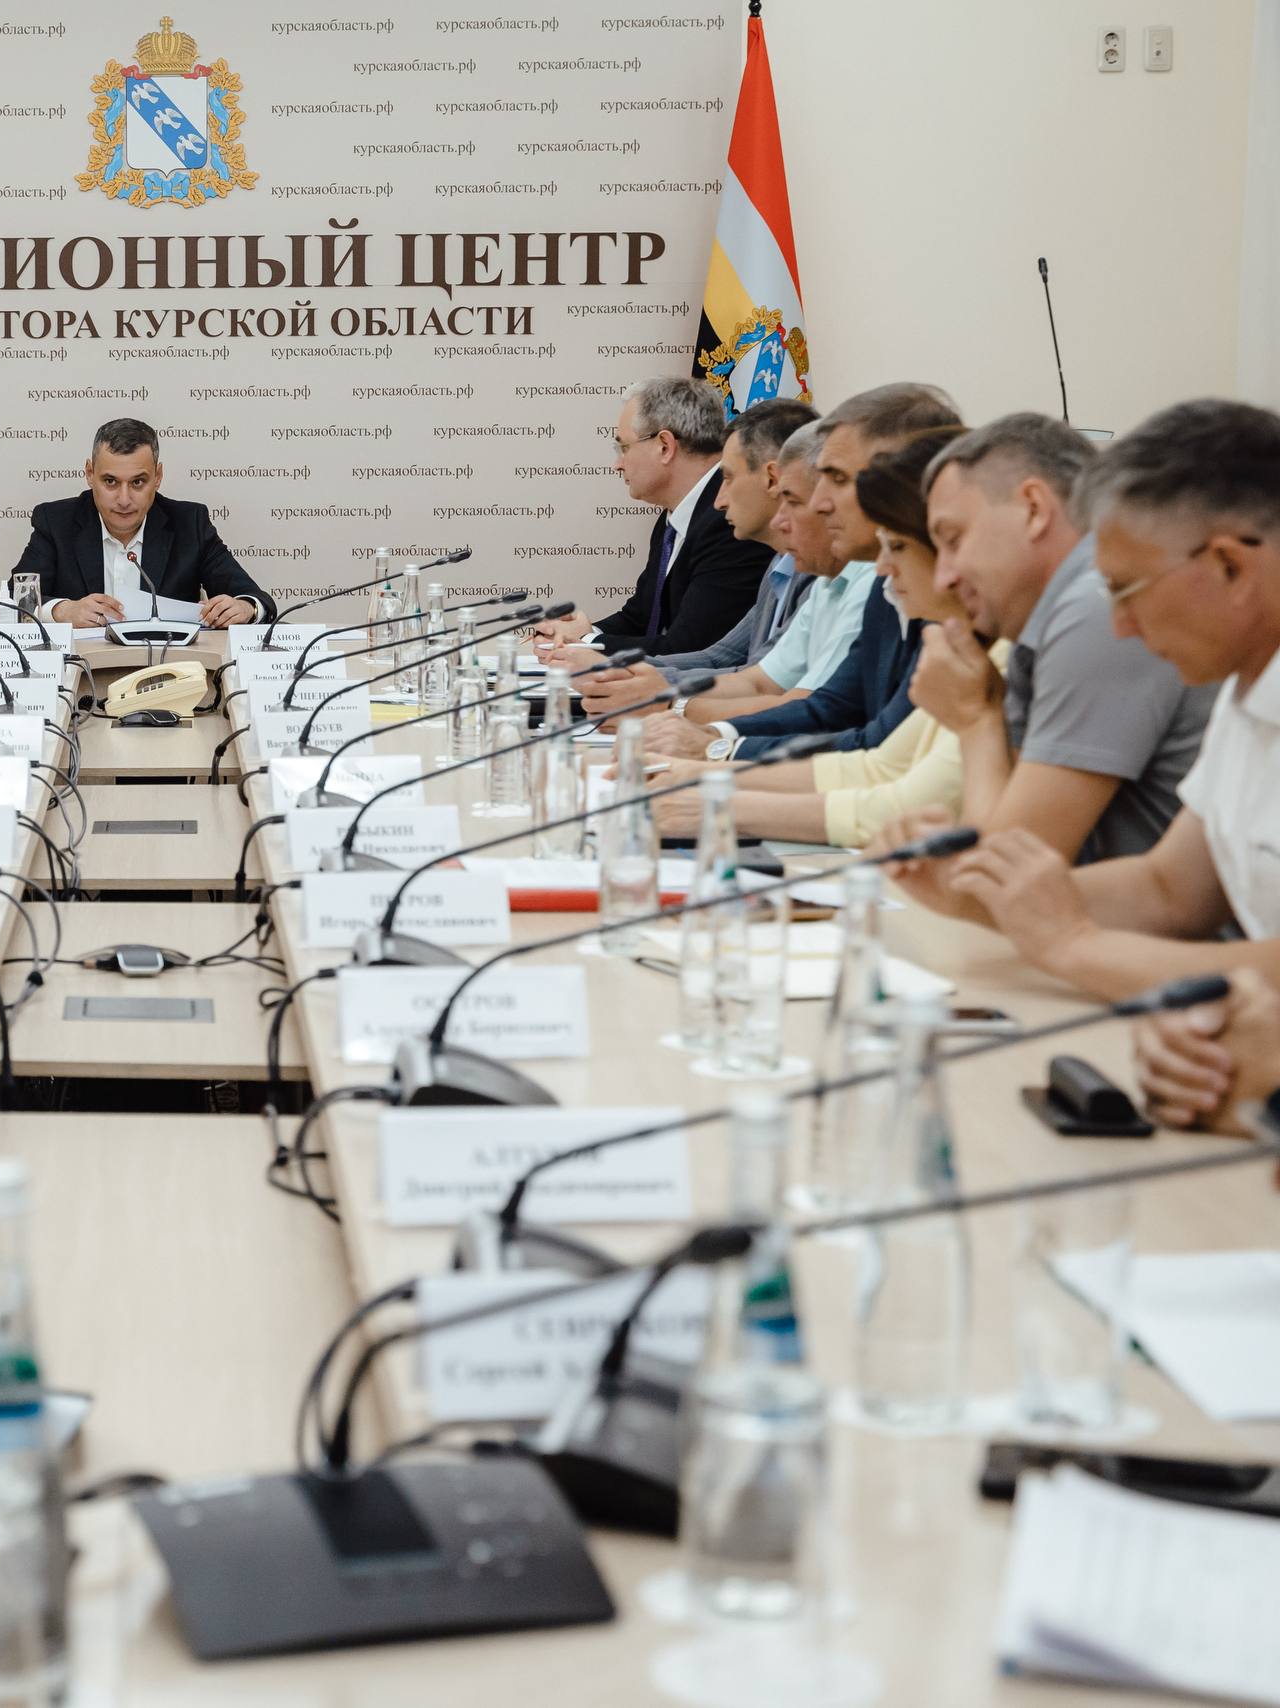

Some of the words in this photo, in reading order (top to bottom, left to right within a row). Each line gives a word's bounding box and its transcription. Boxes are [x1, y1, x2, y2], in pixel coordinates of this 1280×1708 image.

[271, 18, 395, 35] курскаяобласть.рф
[436, 17, 560, 32] курскаяобласть.рф
[601, 15, 725, 32] курскаяобласть.рф
[353, 59, 477, 75] курскаяобласть.рф
[518, 57, 642, 73] курскаяобласть.рф
[271, 101, 394, 119] курскаяобласть.рф
[434, 99, 559, 115] курскаяобласть.рф
[600, 97, 725, 113] курскаяобласть.рф
[353, 140, 476, 157] курскаяобласть.рф
[517, 139, 641, 155] курскаяобласть.рф
[271, 182, 394, 198] курскаяобласть.рф
[434, 181, 558, 197] курскаяобласть.рф
[599, 179, 723, 195] курскаяобласть.рф
[395, 231, 667, 301] ЦЕНТР
[567, 301, 690, 317] курскаяобласть.рф
[113, 300, 318, 338] КУРСКОЙ
[330, 306, 536, 337] ОБЛАСТИ
[108, 345, 230, 361] курскаяобласть.рф
[271, 344, 393, 360] курскаяобласть.рф
[434, 343, 557, 359] курскаяобласть.рф
[597, 342, 695, 358] курскаяобласт
[27, 386, 149, 401] курскаяобласть.рф
[189, 385, 311, 400] курскаяобласть.рф
[351, 384, 474, 400] курскаяобласть.рф
[157, 425, 231, 441] область.рф
[271, 425, 393, 440] курскаяобласть.рф
[433, 424, 556, 439] курскаяобласть.рф
[189, 465, 312, 480] курскаяобласть.рф
[351, 464, 474, 480] курскаяобласть.рф
[270, 505, 392, 520] курскаяобласть.рф
[433, 504, 555, 520] курскаяобласть.рф
[513, 544, 637, 559] курскаяобласть.рф
